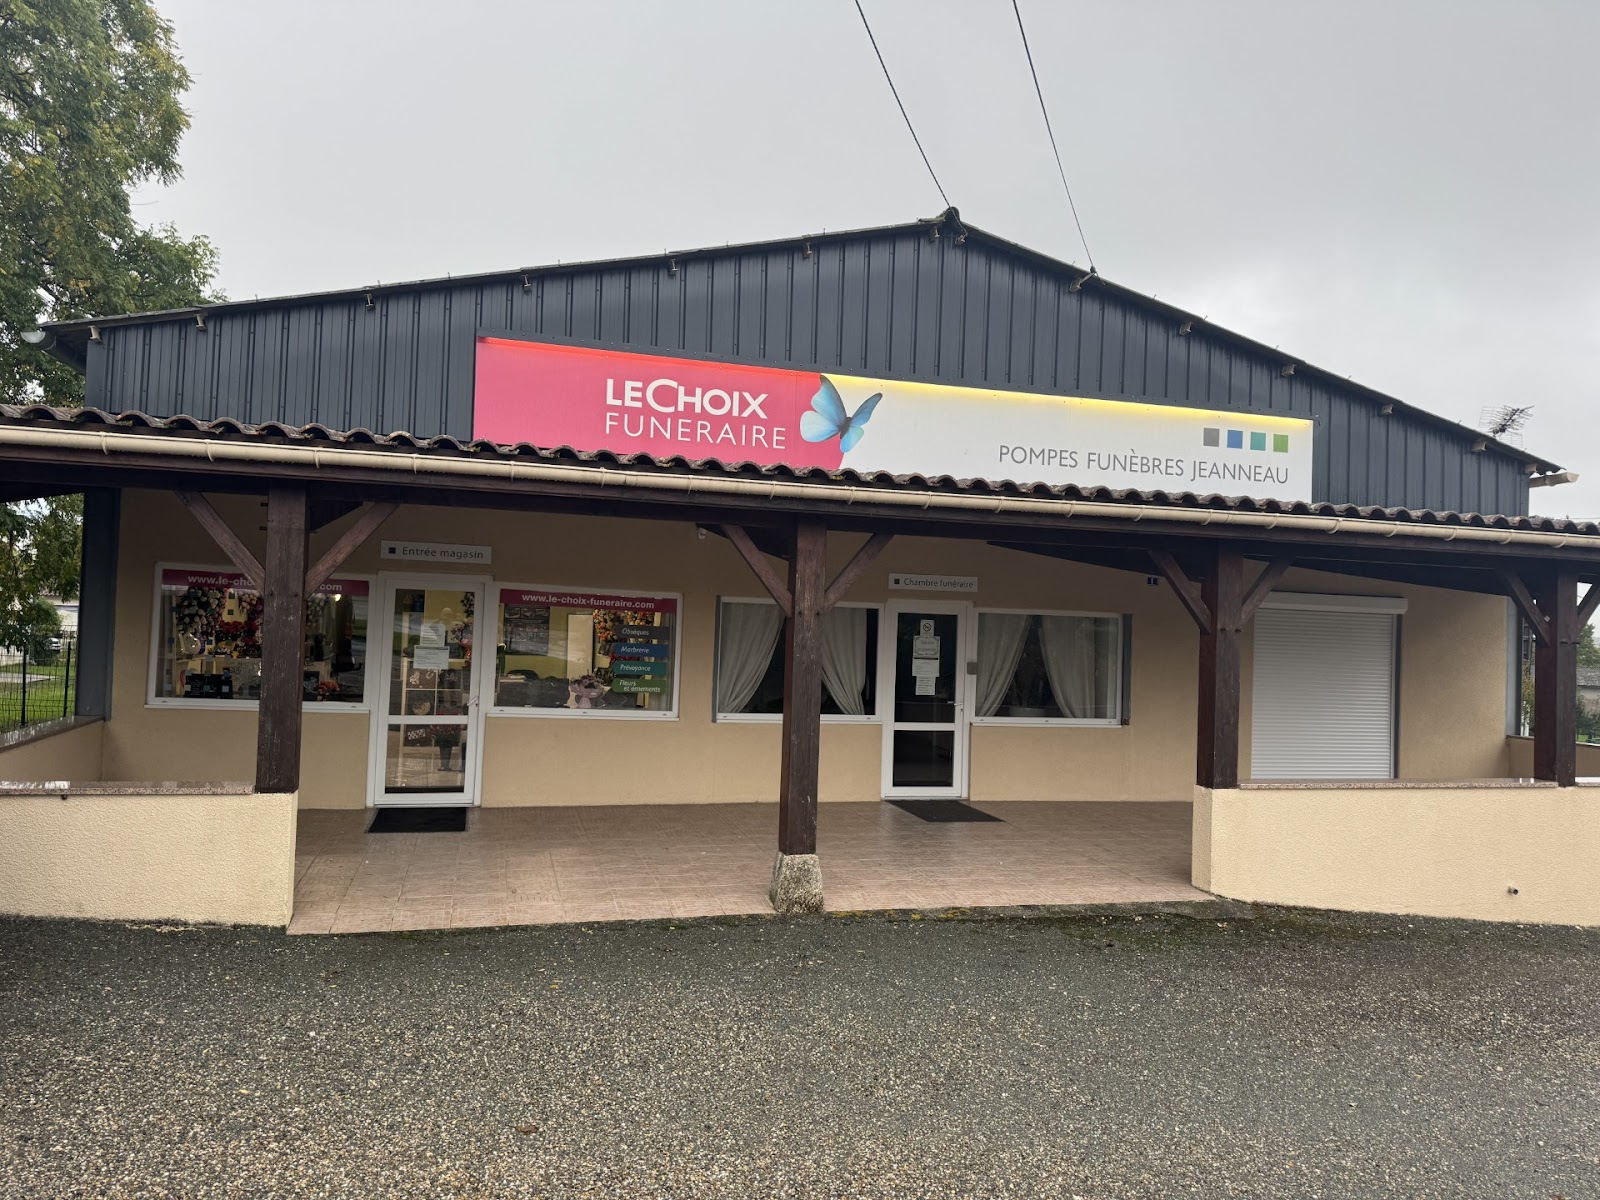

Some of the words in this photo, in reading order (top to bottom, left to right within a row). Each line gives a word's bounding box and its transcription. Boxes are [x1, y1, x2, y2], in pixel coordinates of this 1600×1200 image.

[605, 412, 786, 450] FUNERAIRE
[999, 445, 1079, 469] POMPES
[1087, 448, 1184, 476] FUNÈBRES
[1190, 460, 1289, 485] JEANNEAU
[402, 546, 437, 557] Entrée
[440, 549, 484, 560] magasin
[903, 577, 938, 588] Chambre
[939, 579, 974, 589] funéraire
[521, 594, 655, 609] www.le-choix-funeraire.com
[619, 663, 651, 673] Prévoyance
[619, 679, 637, 687] Fleurs
